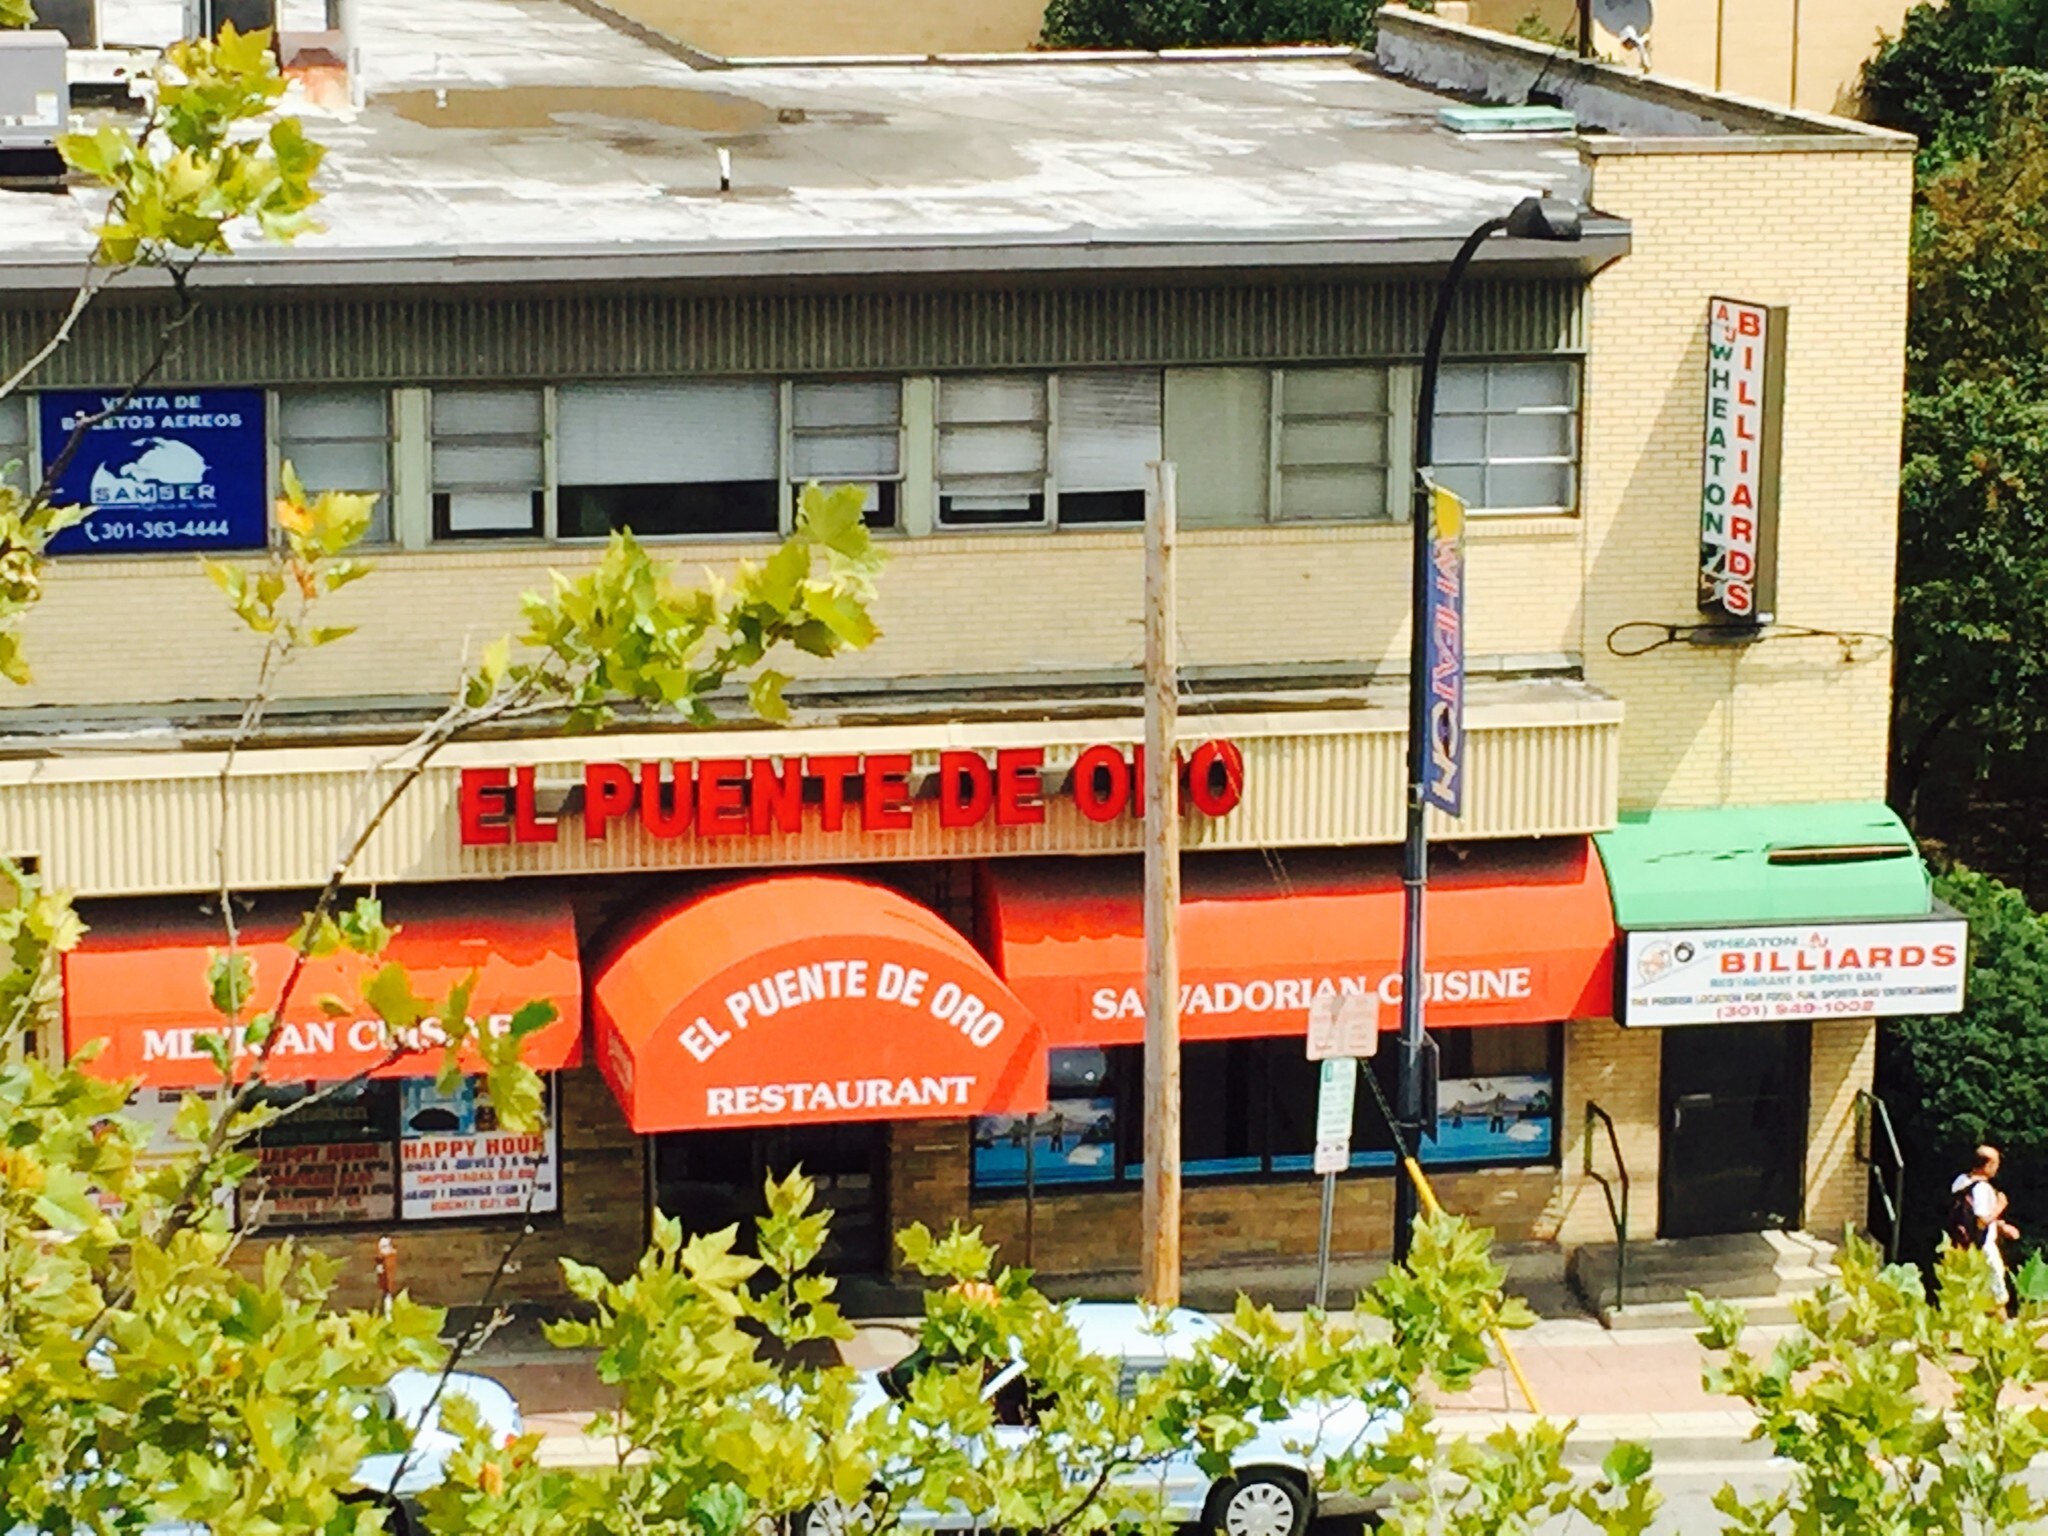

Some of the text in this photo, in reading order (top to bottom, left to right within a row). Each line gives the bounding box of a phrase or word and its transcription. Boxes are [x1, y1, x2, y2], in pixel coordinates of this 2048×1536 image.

[61, 413, 242, 431] BETOS AEREOS
[101, 395, 202, 410] VNTA DE
[1703, 342, 1734, 535] WHEATON
[1727, 311, 1761, 612] BILLIARDS
[1430, 534, 1460, 804] WHEATON
[461, 766, 558, 846] EL
[585, 753, 913, 840] PUENTE
[940, 748, 1044, 828] DE
[1702, 937, 1798, 949] WHEATON
[1720, 944, 1957, 974] BILLIARDS
[1091, 975, 1367, 1020] SAVADORIAN
[1709, 976, 1792, 988] RESTAURANT
[678, 1016, 732, 1063] EL
[724, 959, 868, 1030] PUENTE
[876, 962, 929, 1008] DE
[929, 981, 1005, 1048] ORO
[1716, 1004, 1769, 1019] (301)
[141, 1013, 515, 1061] MEIAN CUISE
[706, 1075, 976, 1117] RESTAURANT
[403, 1136, 545, 1159] HAPPY HOUR
